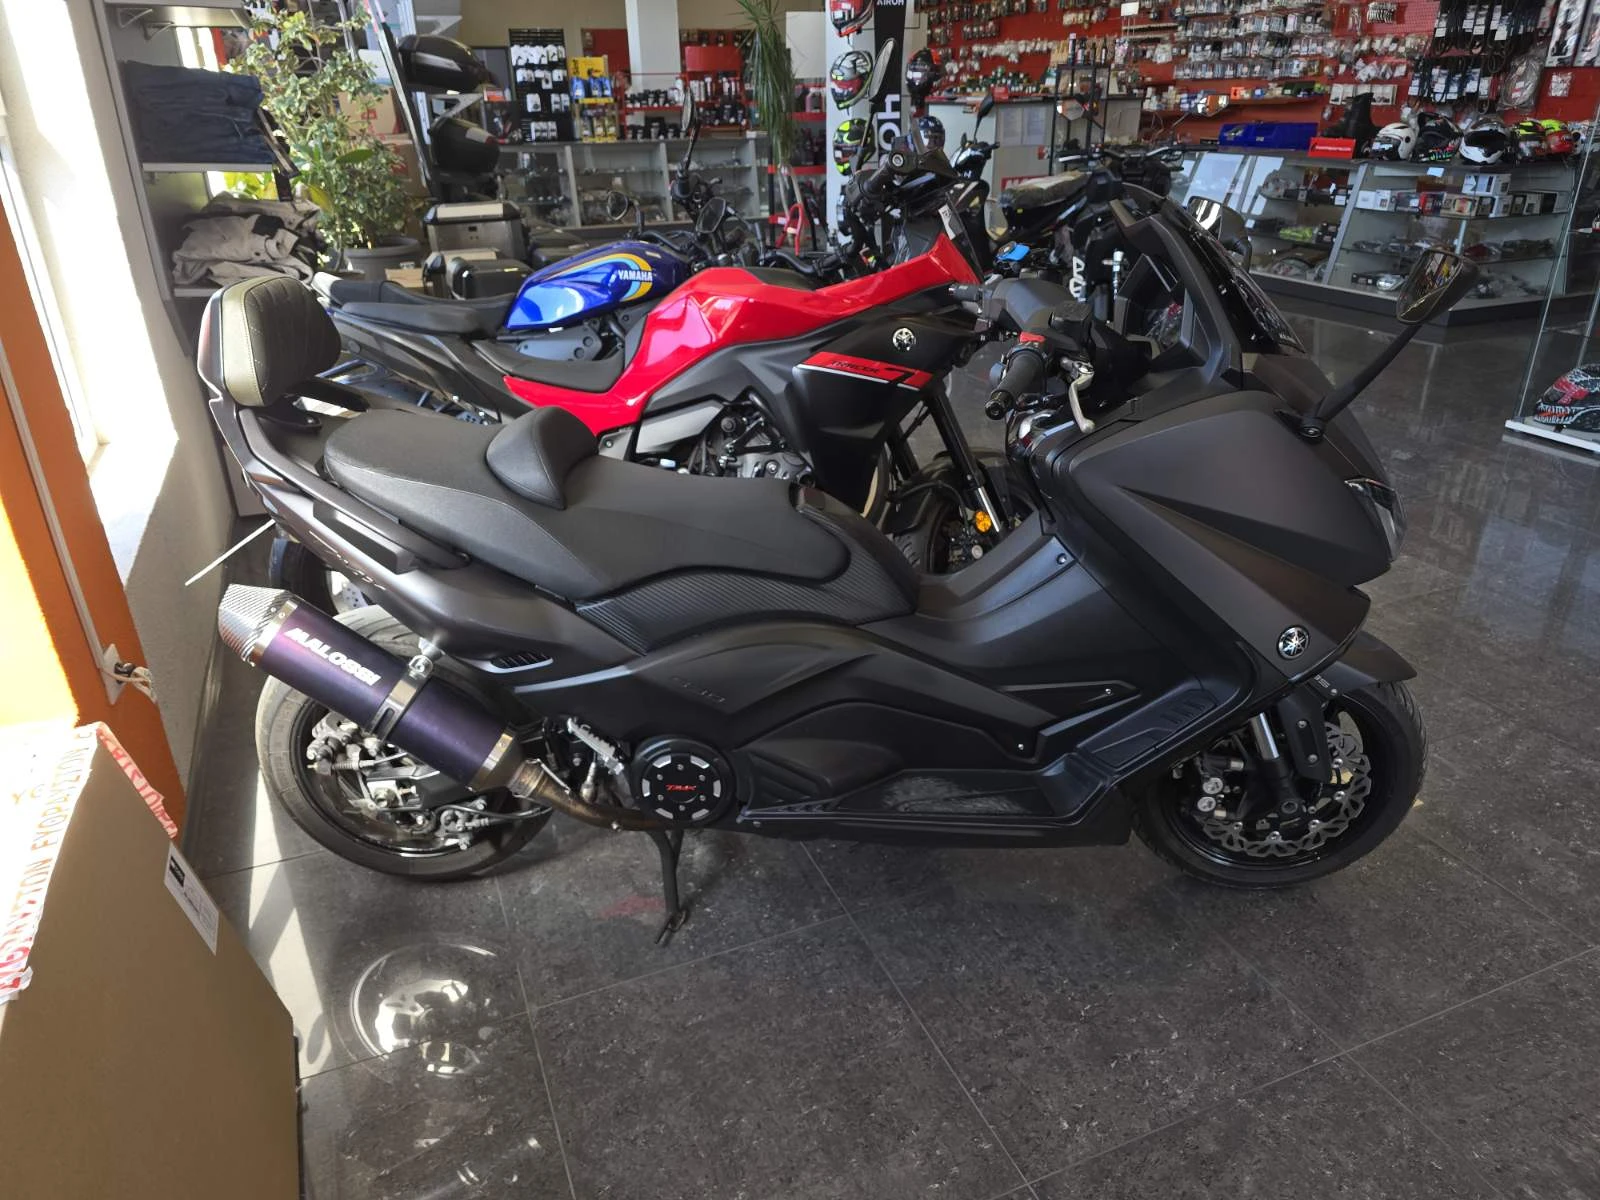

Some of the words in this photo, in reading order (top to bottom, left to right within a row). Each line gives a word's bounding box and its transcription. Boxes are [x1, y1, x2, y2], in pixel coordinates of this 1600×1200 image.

[618, 269, 653, 282] YAMAHA
[831, 360, 881, 374] TRACER
[884, 366, 918, 386] 7
[284, 627, 381, 687] MALOSSI
